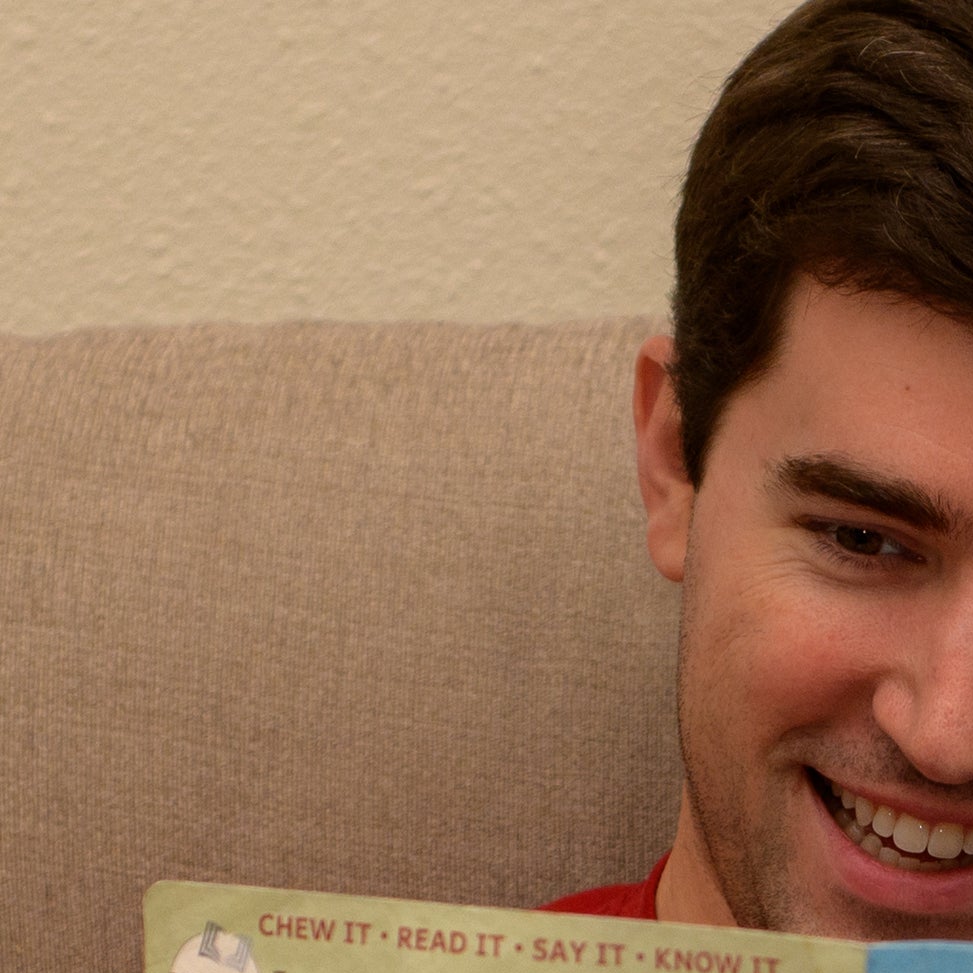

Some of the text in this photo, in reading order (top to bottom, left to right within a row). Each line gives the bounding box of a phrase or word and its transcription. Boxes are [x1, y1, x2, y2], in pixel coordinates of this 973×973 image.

[259, 913, 336, 941] CHEW
[344, 920, 372, 945] IT
[397, 926, 467, 955] READ
[476, 932, 505, 957] IT
[531, 937, 588, 965] SAY
[596, 941, 626, 967] IT
